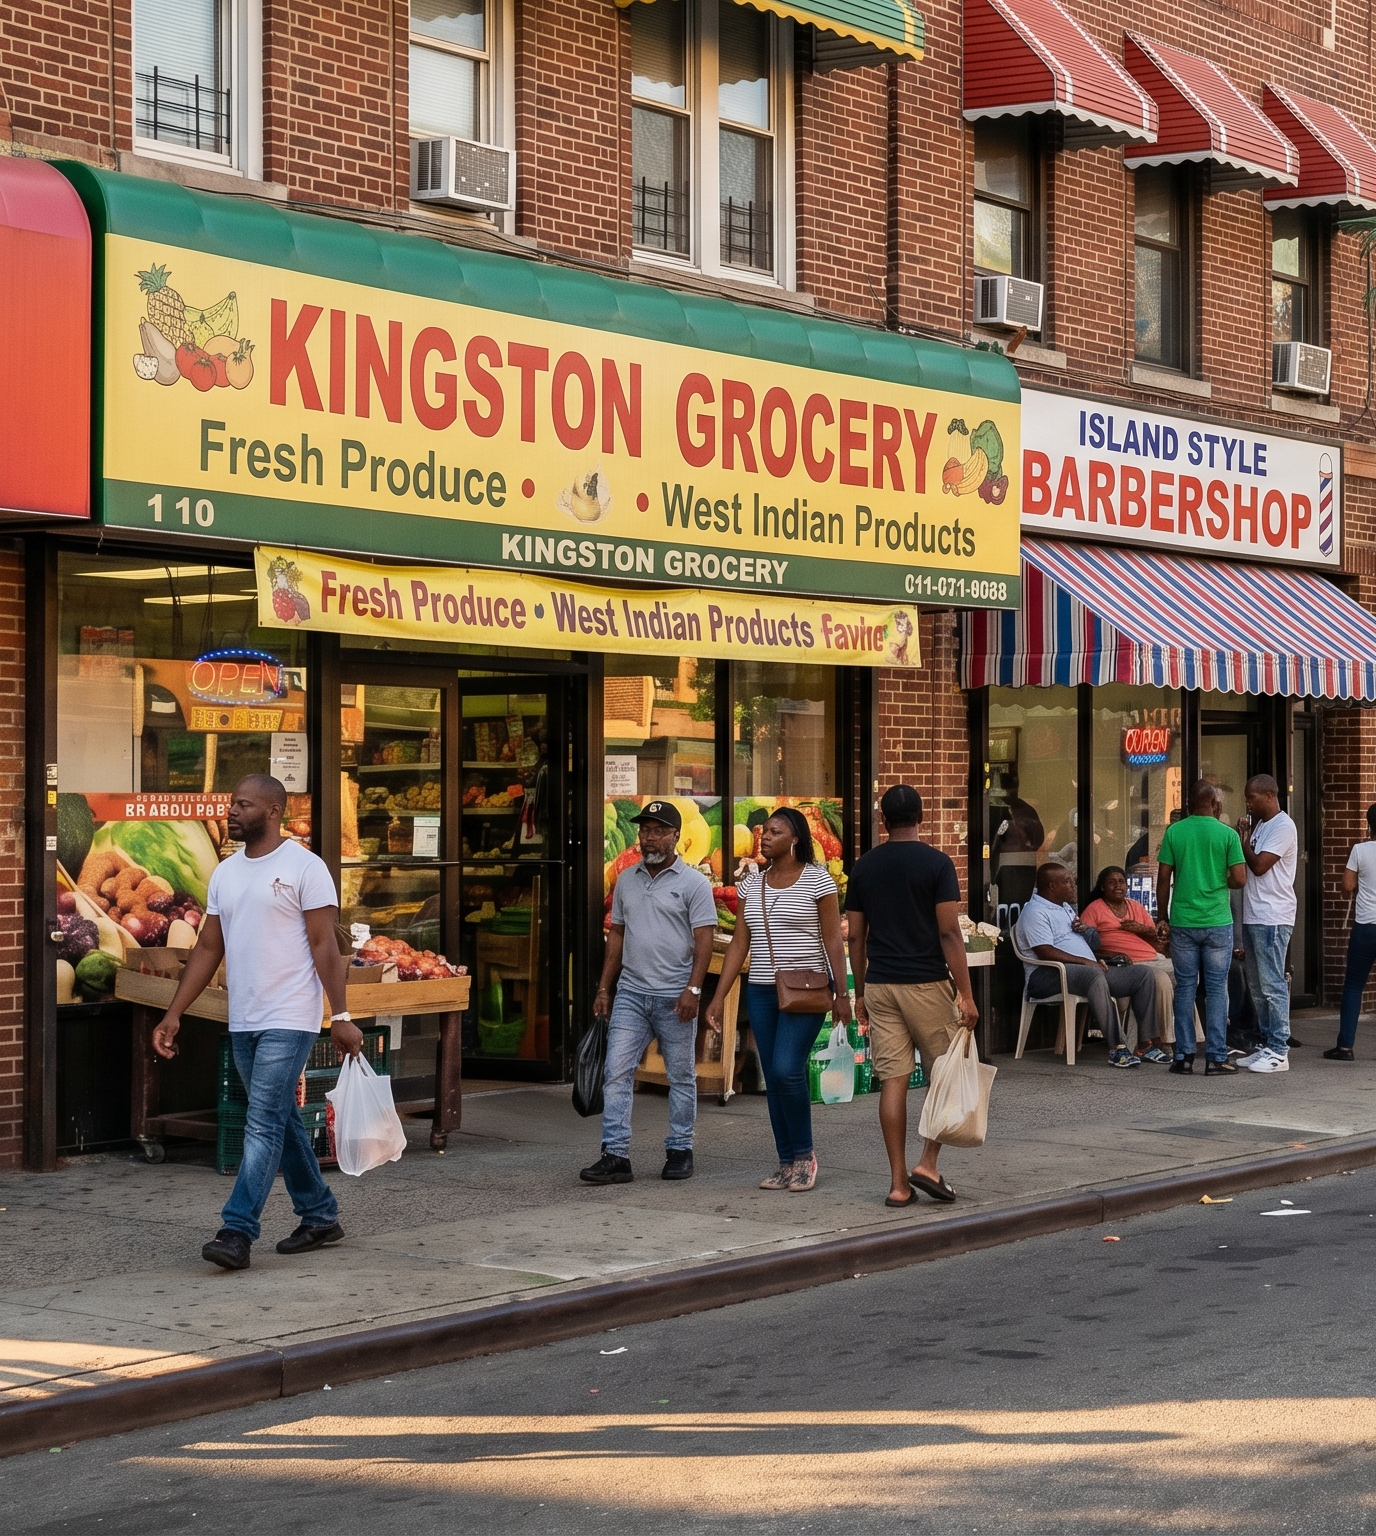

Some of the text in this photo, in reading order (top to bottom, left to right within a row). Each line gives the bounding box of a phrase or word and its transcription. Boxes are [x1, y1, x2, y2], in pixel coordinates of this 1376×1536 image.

[270, 298, 938, 494] KINGSTON GROCERY
[200, 418, 507, 508] Fresh Produce
[1079, 410, 1268, 477] ISLAND STYLE
[661, 481, 976, 558] West Indian Products
[1022, 449, 1312, 549] BARBERSHOP
[502, 532, 788, 585] KINGSTON GROCERY
[320, 571, 405, 618] Fresh
[410, 580, 527, 629] Produce
[550, 592, 617, 638] West
[625, 598, 701, 641] Indian
[710, 605, 815, 649] Products
[192, 661, 279, 696] OPEN
